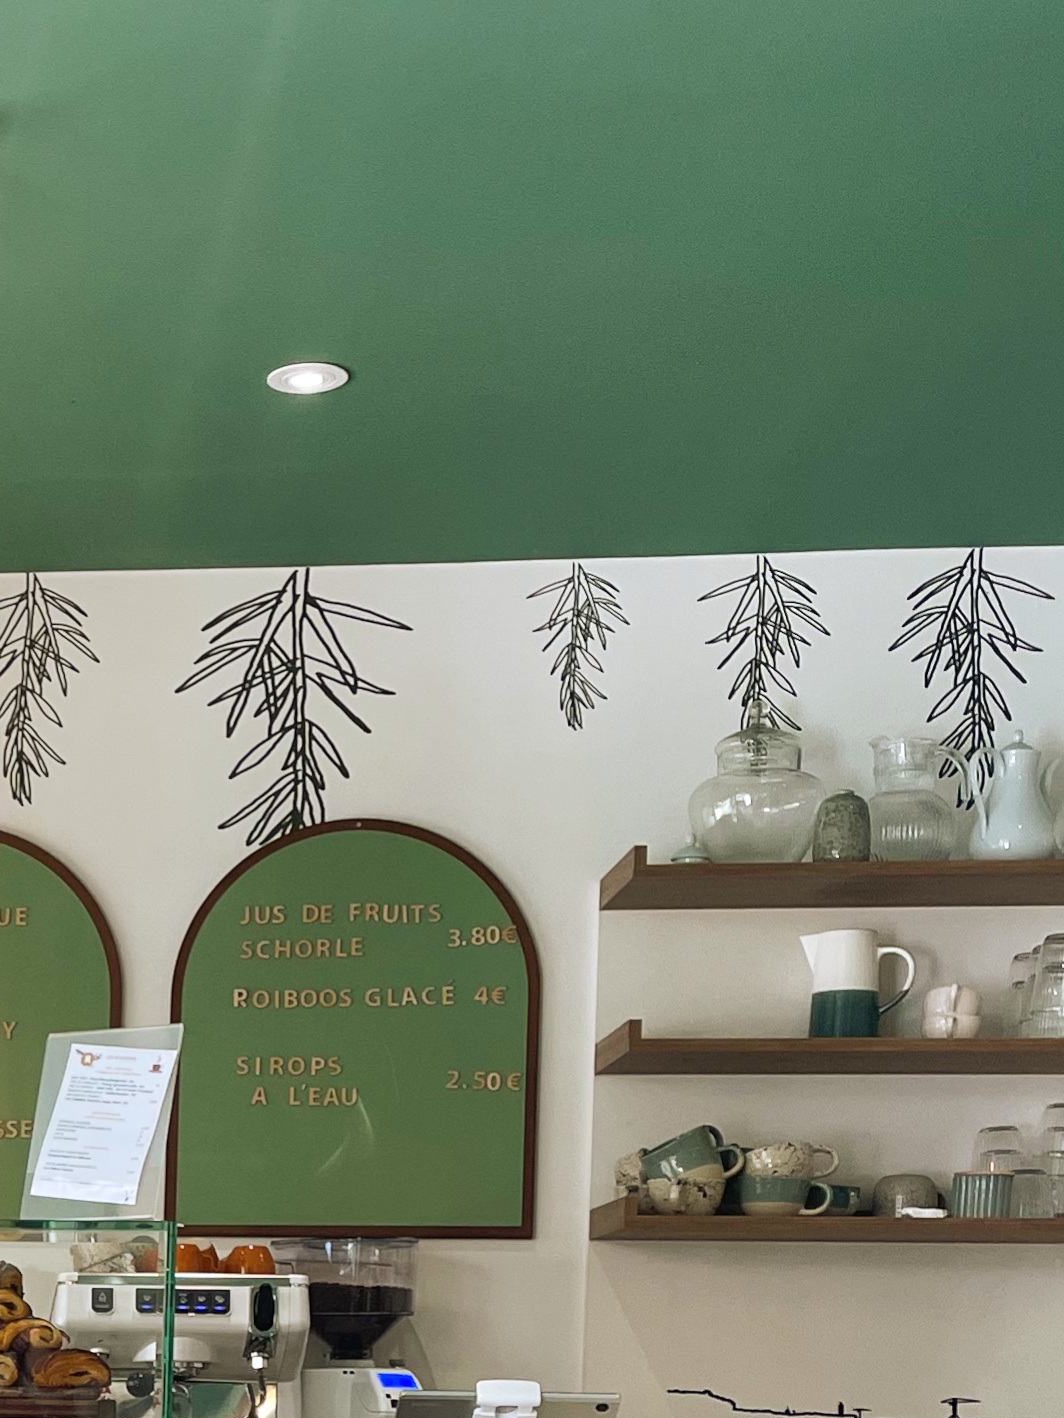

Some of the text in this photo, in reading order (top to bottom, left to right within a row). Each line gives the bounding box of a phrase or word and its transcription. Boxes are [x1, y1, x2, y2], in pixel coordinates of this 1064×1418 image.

[241, 904, 440, 924] JUS DE FRUITS
[241, 925, 518, 958] SCHORLE 3.80€
[233, 989, 350, 1009] ROIBOOS
[237, 1057, 341, 1075] SIROPS
[252, 1071, 519, 1106] A L'EAU 2.50€
